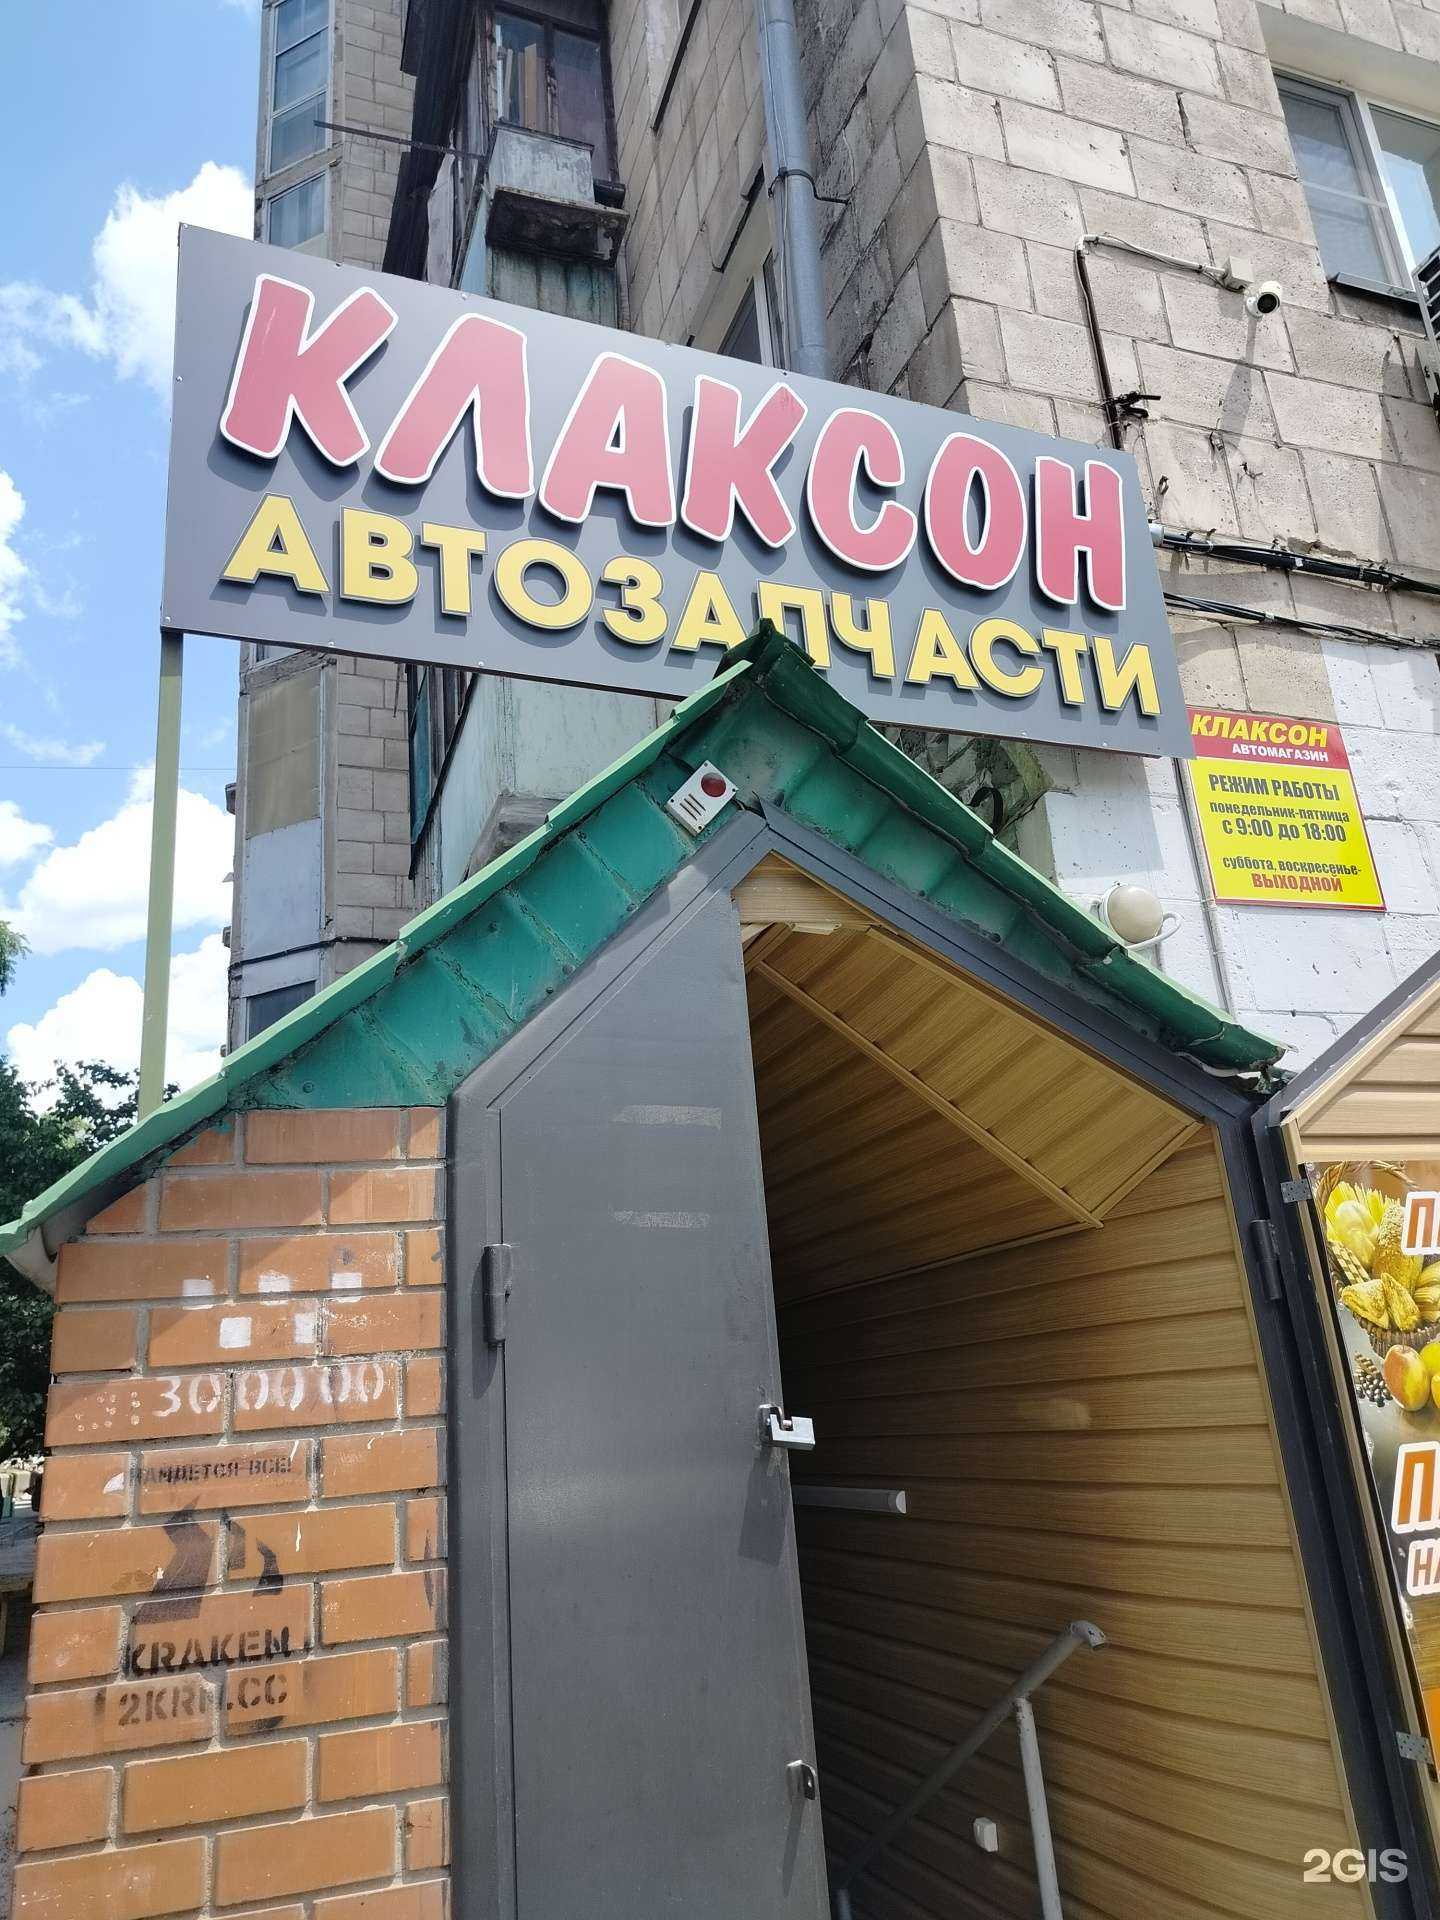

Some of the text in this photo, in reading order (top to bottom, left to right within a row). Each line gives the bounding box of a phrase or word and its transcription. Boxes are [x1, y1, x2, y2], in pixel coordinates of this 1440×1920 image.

[220, 273, 1127, 611] КЛАКСОН
[220, 492, 1162, 717] АВТОЗАПЧАСТИ
[1191, 713, 1328, 748] КЛАКСОН
[1232, 743, 1329, 762] АВТОМАГАЗИН
[1208, 774, 1340, 801] РЕЖИМ РАБОТЫ
[1235, 818, 1274, 837] 9:00
[1278, 823, 1300, 841] до
[1304, 823, 1347, 842] 18:00
[1222, 856, 1277, 871] суббота,
[1251, 871, 1344, 893] ВЫХОДНОЙ
